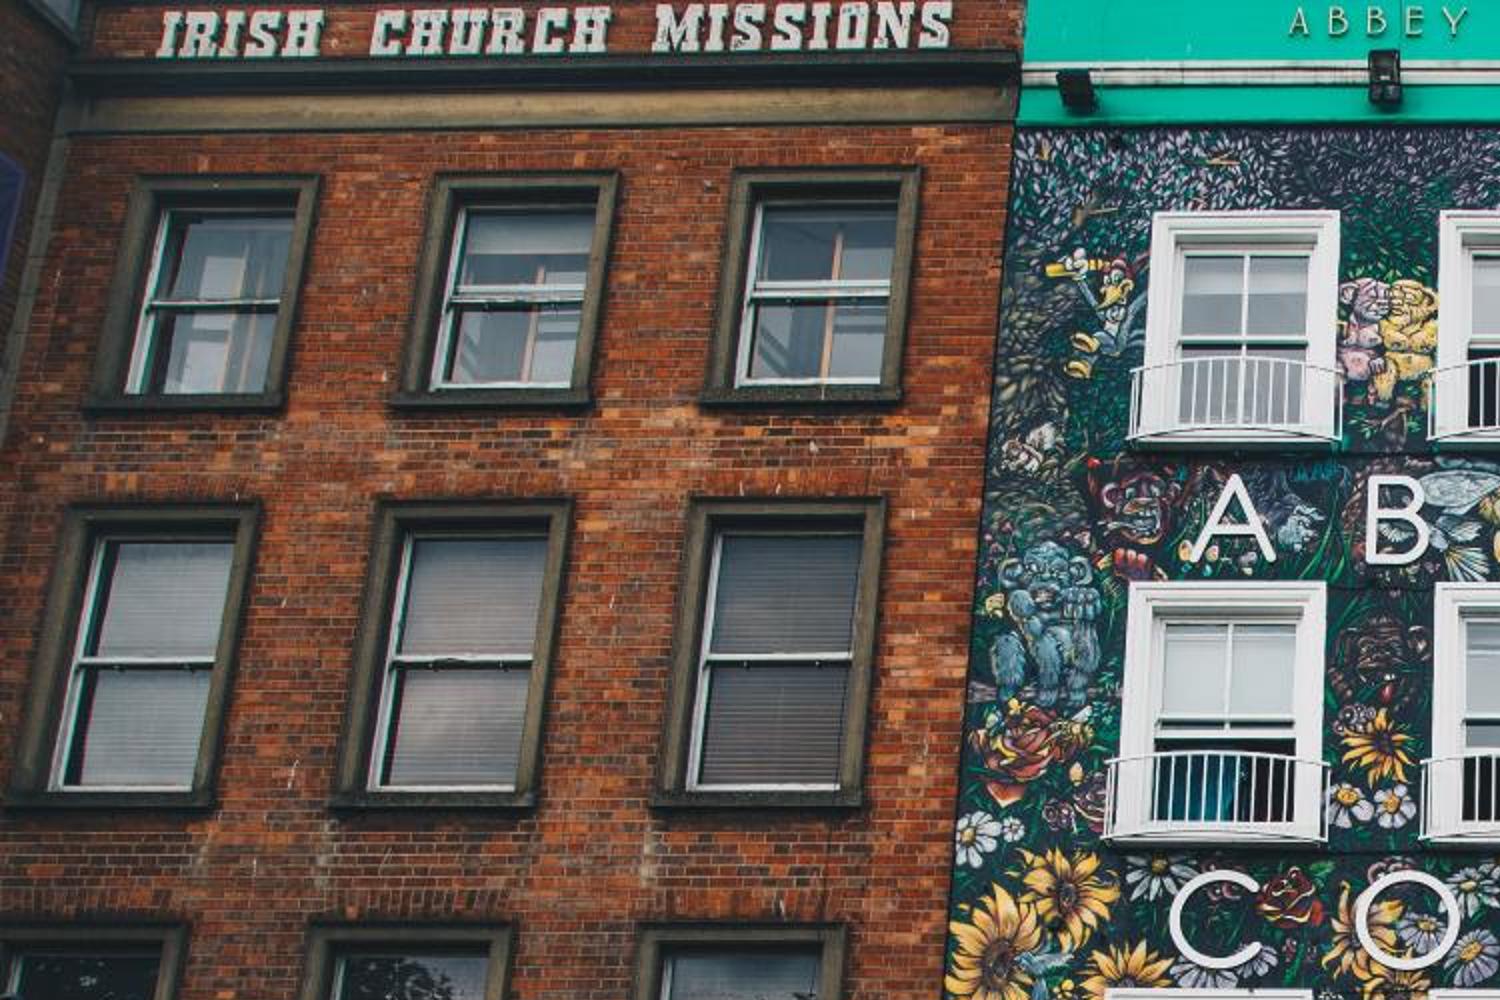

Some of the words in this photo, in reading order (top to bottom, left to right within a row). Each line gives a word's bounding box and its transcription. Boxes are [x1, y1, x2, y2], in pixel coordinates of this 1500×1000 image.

[156, 10, 325, 57] IRISH
[369, 7, 612, 55] CHURCH
[652, 1, 953, 52] MISSIONS
[1289, 7, 1467, 37] ABBEY
